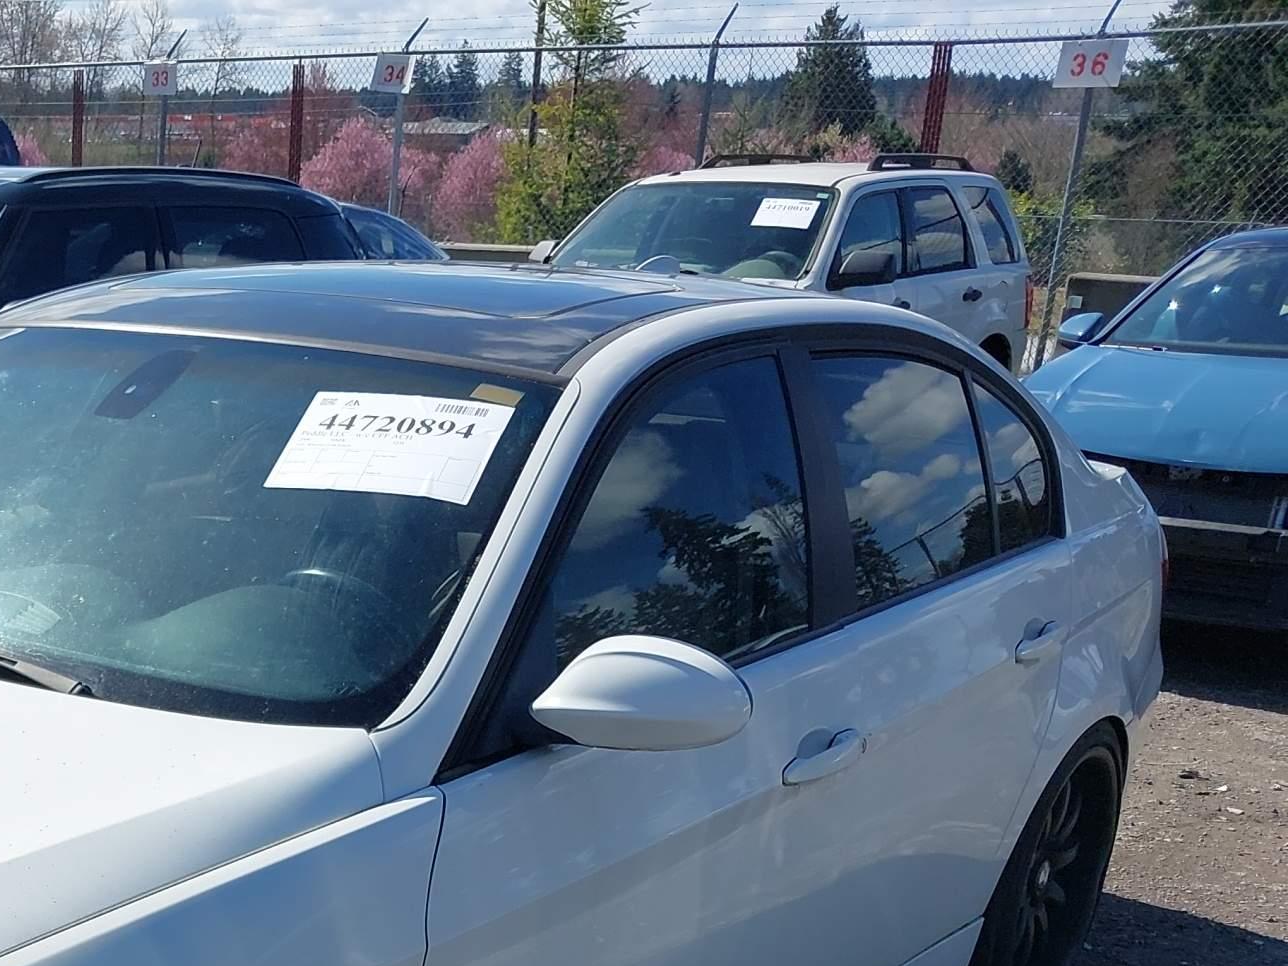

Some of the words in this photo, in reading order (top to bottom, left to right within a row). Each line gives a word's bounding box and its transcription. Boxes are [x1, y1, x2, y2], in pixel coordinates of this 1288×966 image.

[383, 64, 406, 84] 34
[1070, 52, 1109, 77] 36
[152, 71, 169, 87] 33
[318, 413, 477, 440] 44720894
